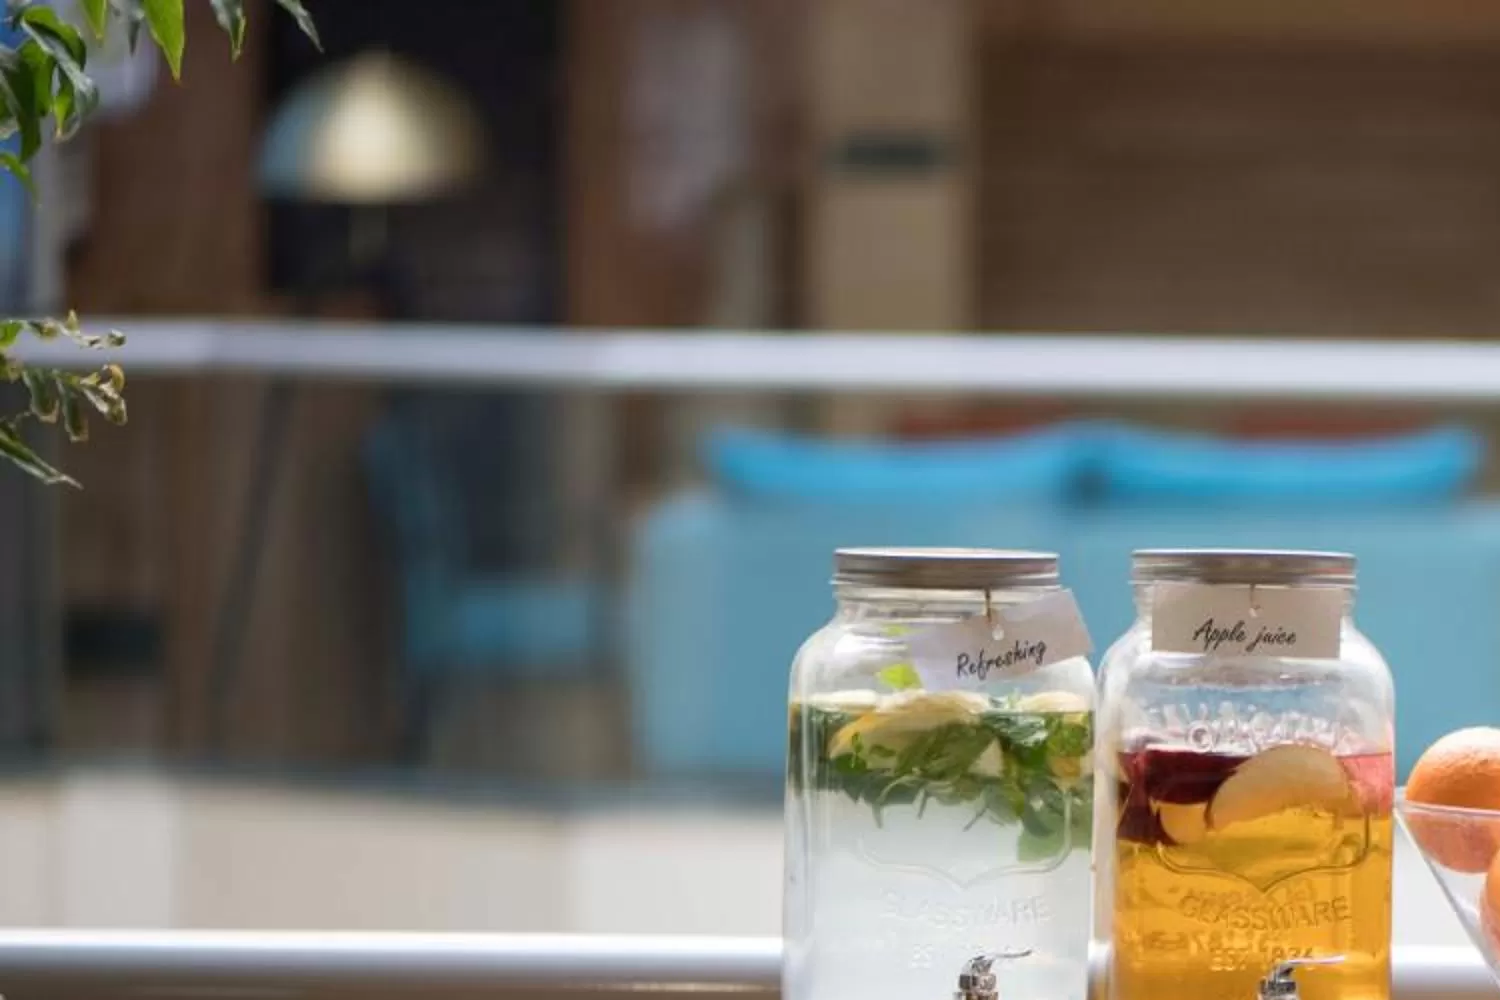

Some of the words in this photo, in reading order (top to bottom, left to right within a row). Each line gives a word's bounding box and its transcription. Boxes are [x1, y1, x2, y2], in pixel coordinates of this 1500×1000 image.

[1192, 617, 1246, 651] Apple
[1245, 625, 1297, 652] juice
[957, 639, 1047, 680] Refreshing
